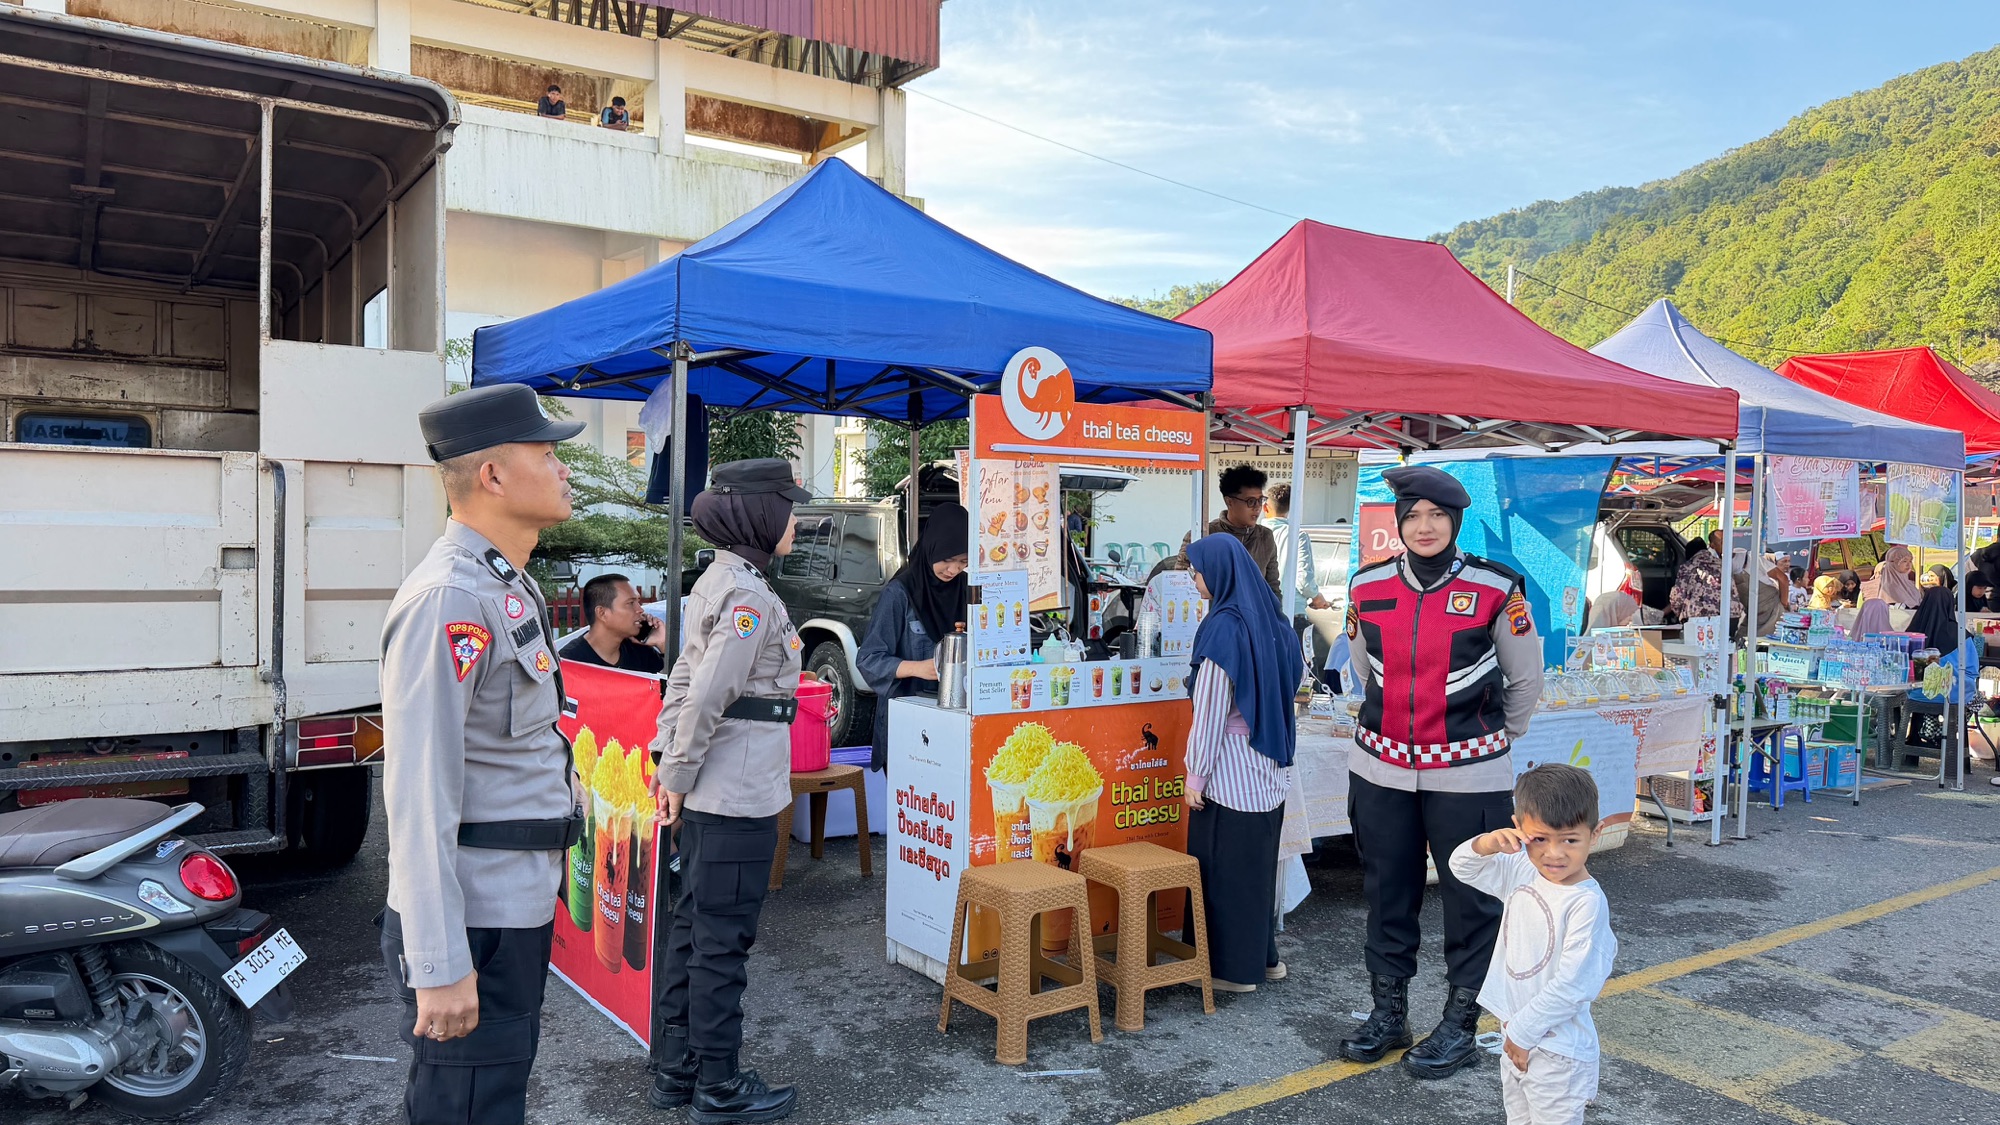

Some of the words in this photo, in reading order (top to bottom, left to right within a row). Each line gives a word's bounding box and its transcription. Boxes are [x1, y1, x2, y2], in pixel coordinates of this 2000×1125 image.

[1083, 420, 1112, 439] thai
[1144, 425, 1192, 445] cheesy
[449, 624, 467, 633] OPS
[1112, 776, 1149, 805] thai
[1115, 804, 1180, 829] cheesy
[597, 881, 610, 903] thai
[599, 900, 620, 924] cheesy
[227, 969, 248, 989] BA
[244, 944, 275, 974] 3015
[274, 931, 292, 950] ME
